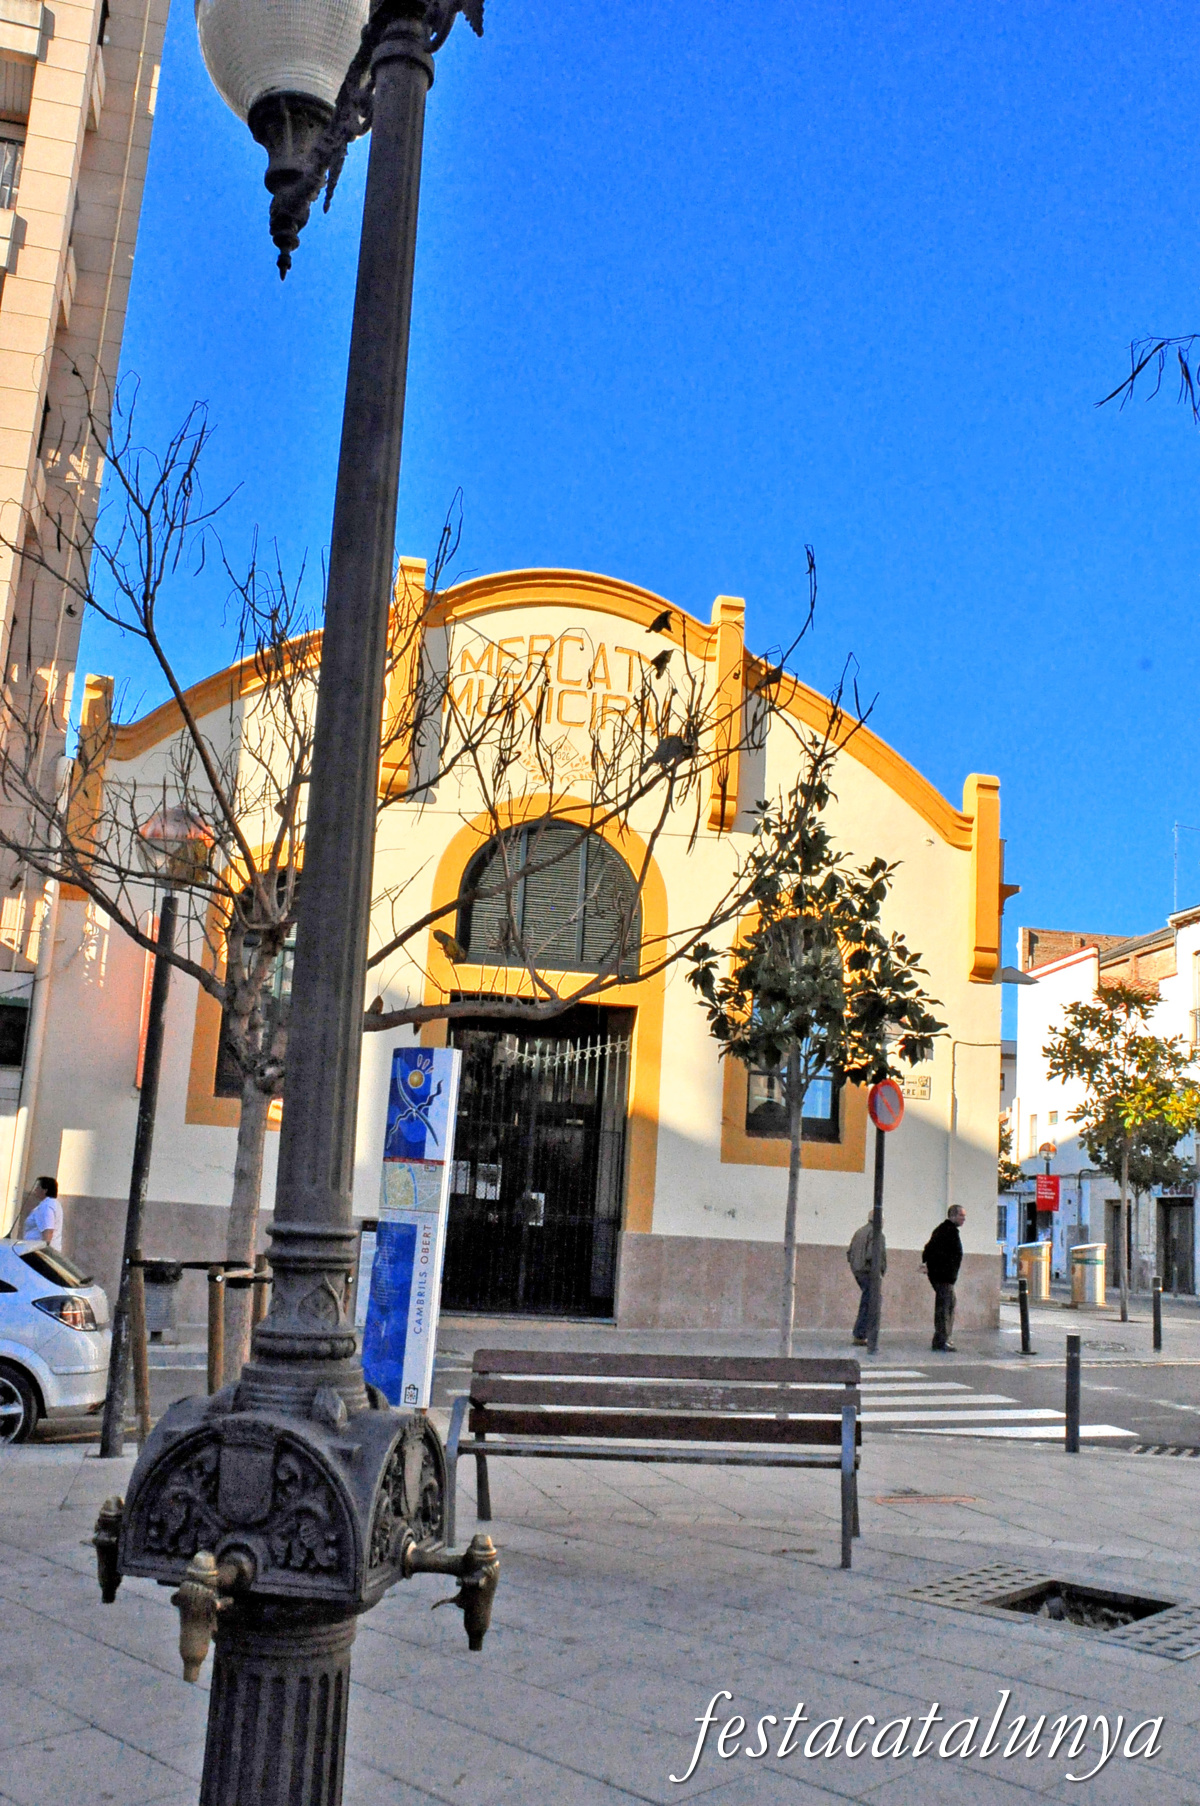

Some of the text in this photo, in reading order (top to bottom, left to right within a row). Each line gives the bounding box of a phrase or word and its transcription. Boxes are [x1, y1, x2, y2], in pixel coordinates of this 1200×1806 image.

[460, 634, 652, 692] MERCAT
[413, 1224, 432, 1335] CAMBRILS OBERT
